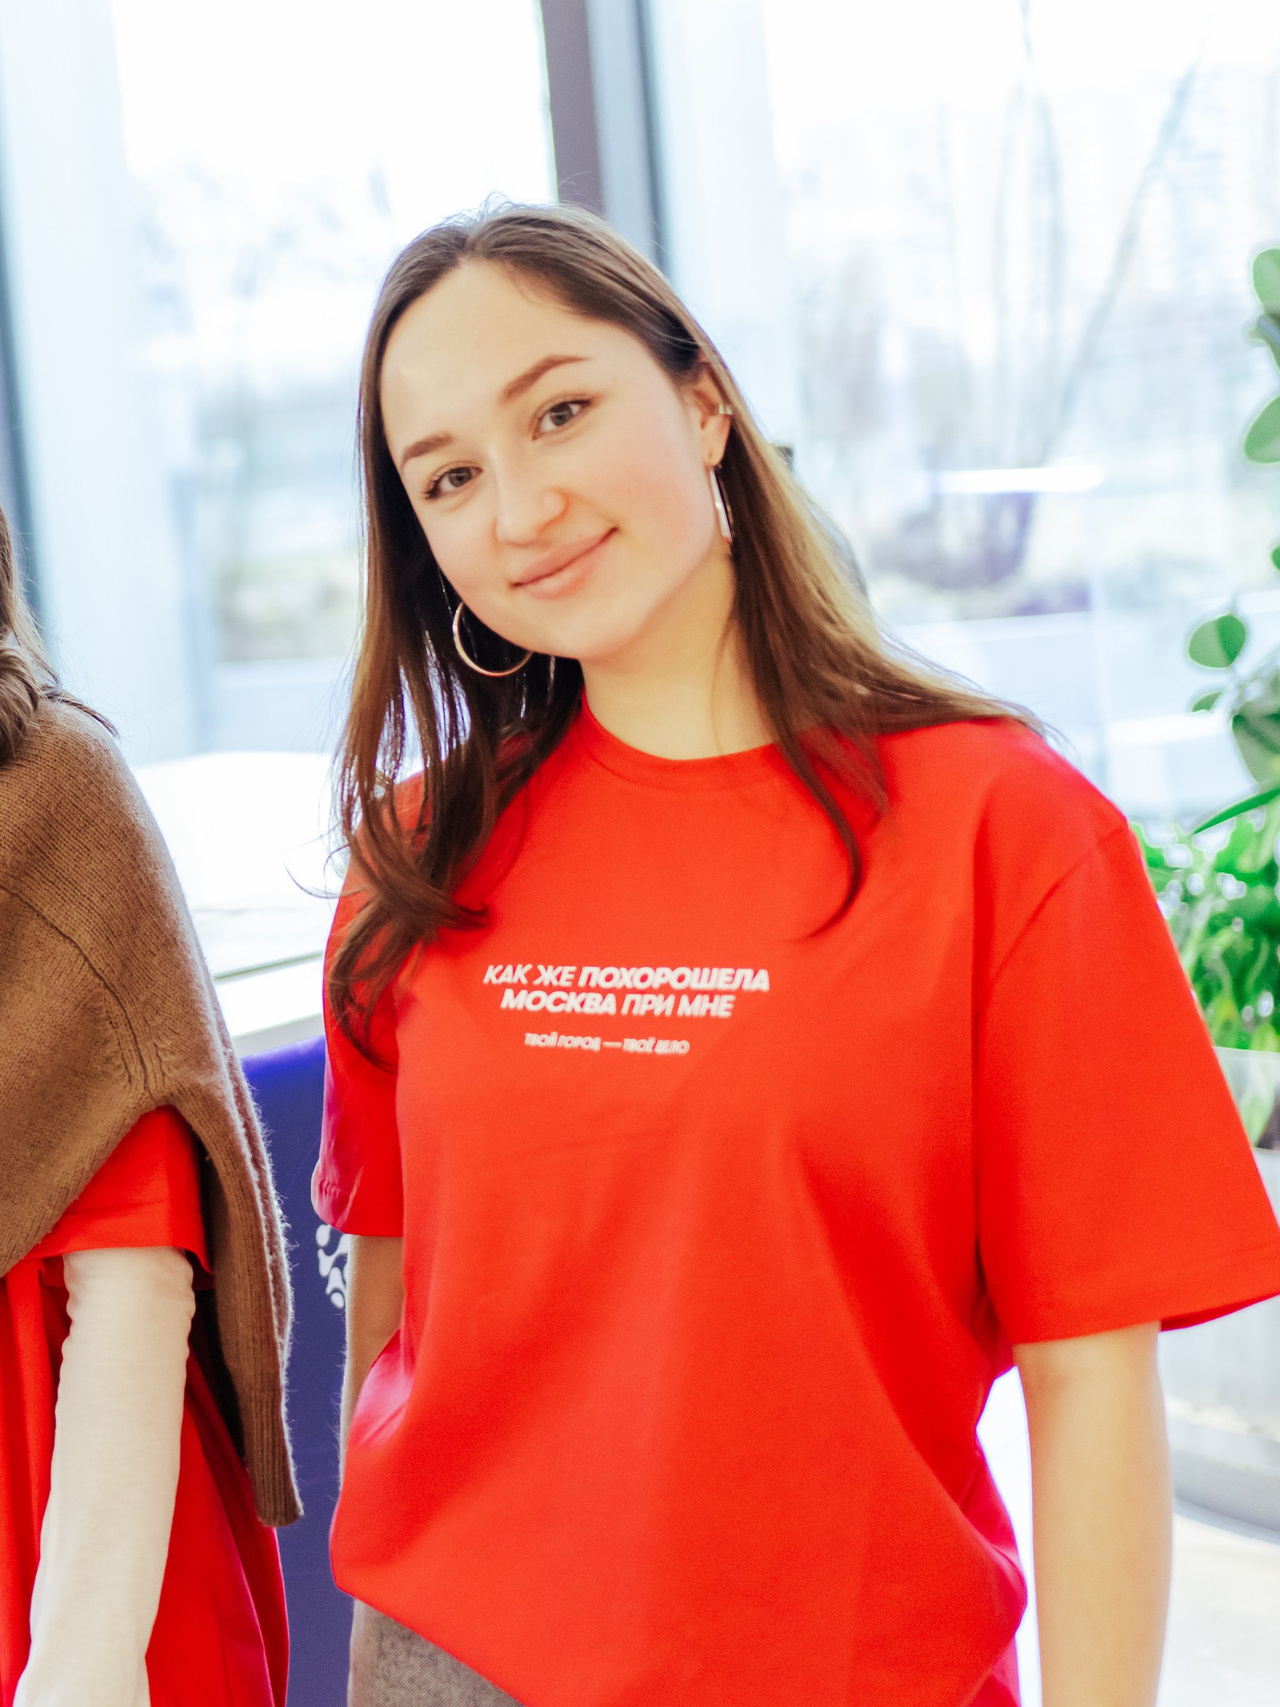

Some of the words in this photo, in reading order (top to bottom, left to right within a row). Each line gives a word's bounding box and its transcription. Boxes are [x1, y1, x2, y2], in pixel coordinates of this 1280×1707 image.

[483, 964, 535, 984] КАК
[533, 965, 577, 987] ЖЕ
[577, 966, 771, 992] ПОХОРОШЕЛА
[500, 988, 617, 1016] МОСКВА
[621, 993, 675, 1017] ПРИ
[677, 993, 737, 1019] МНЕ
